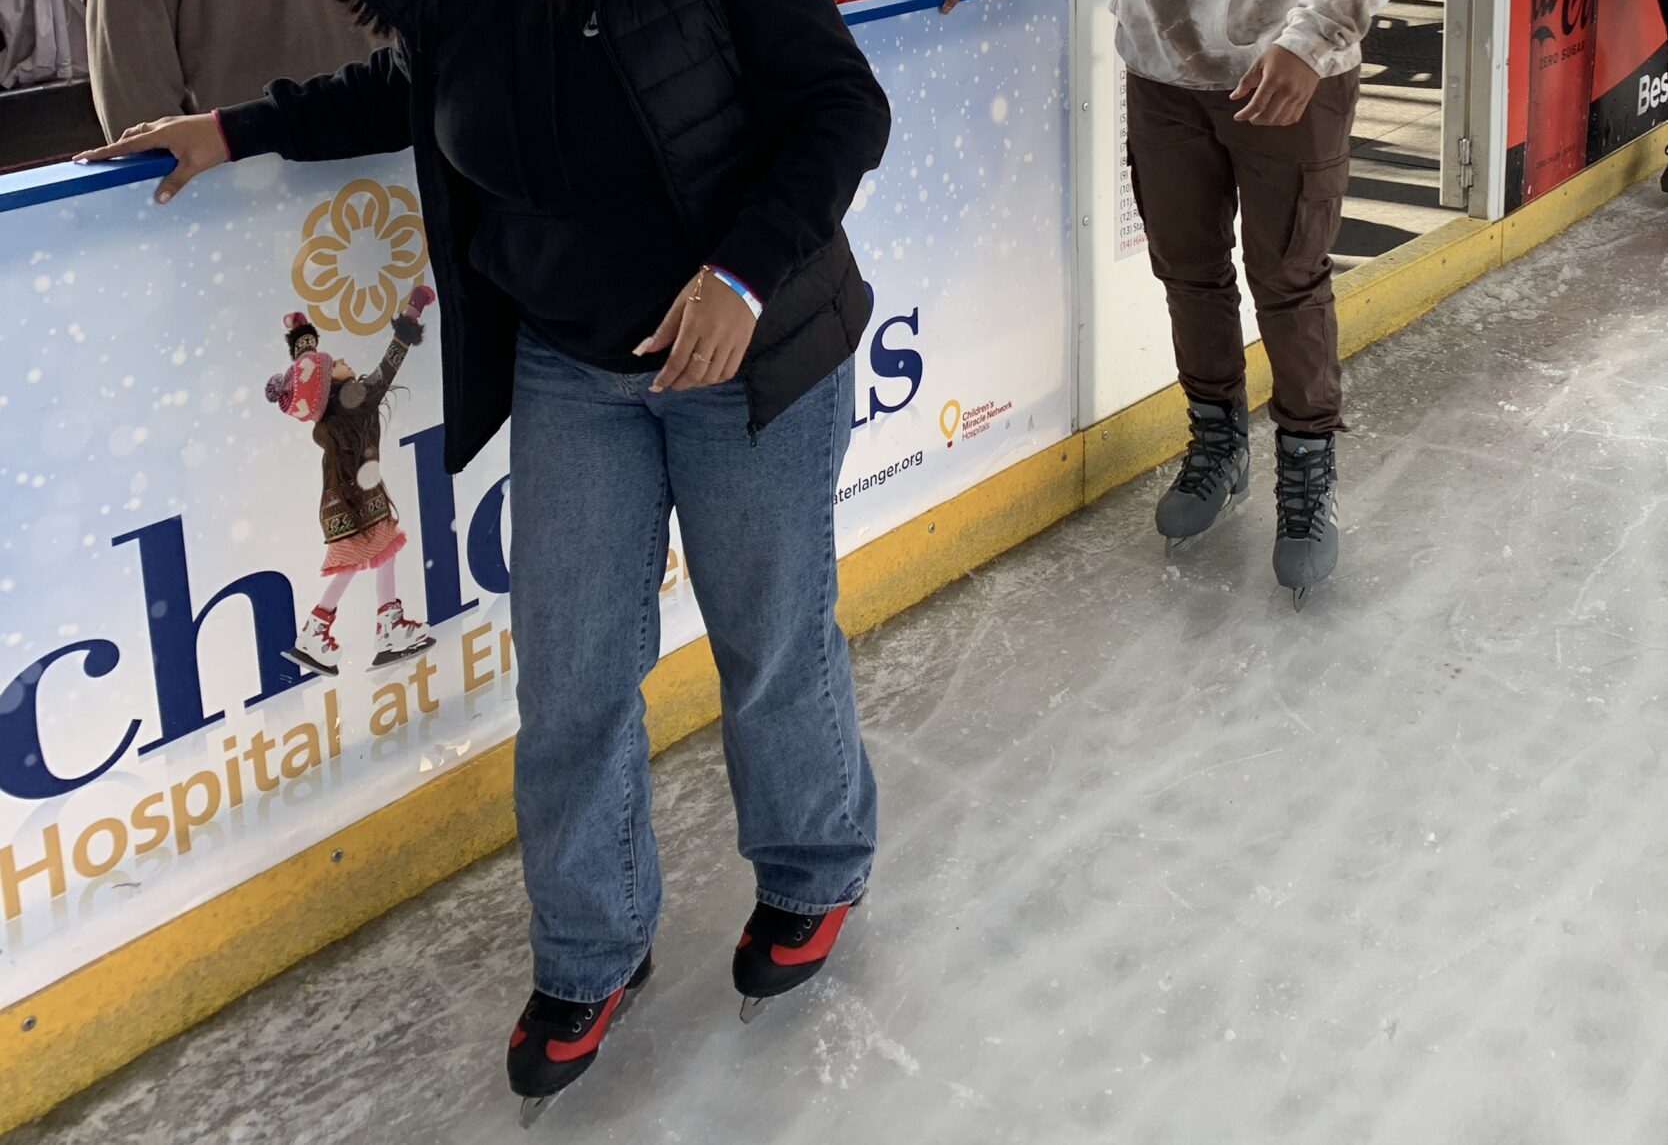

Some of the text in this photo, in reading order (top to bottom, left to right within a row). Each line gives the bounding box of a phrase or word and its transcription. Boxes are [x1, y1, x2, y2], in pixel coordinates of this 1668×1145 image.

[1540, 40, 1585, 70] ZERO SUGAR
[1133, 234, 1149, 246] HAV
[962, 401, 994, 422] Children's
[962, 400, 1013, 432] Miracle Network
[961, 421, 990, 442] Hospitals
[832, 449, 924, 506] aterlanger.org
[0, 663, 440, 922] Hospital at
